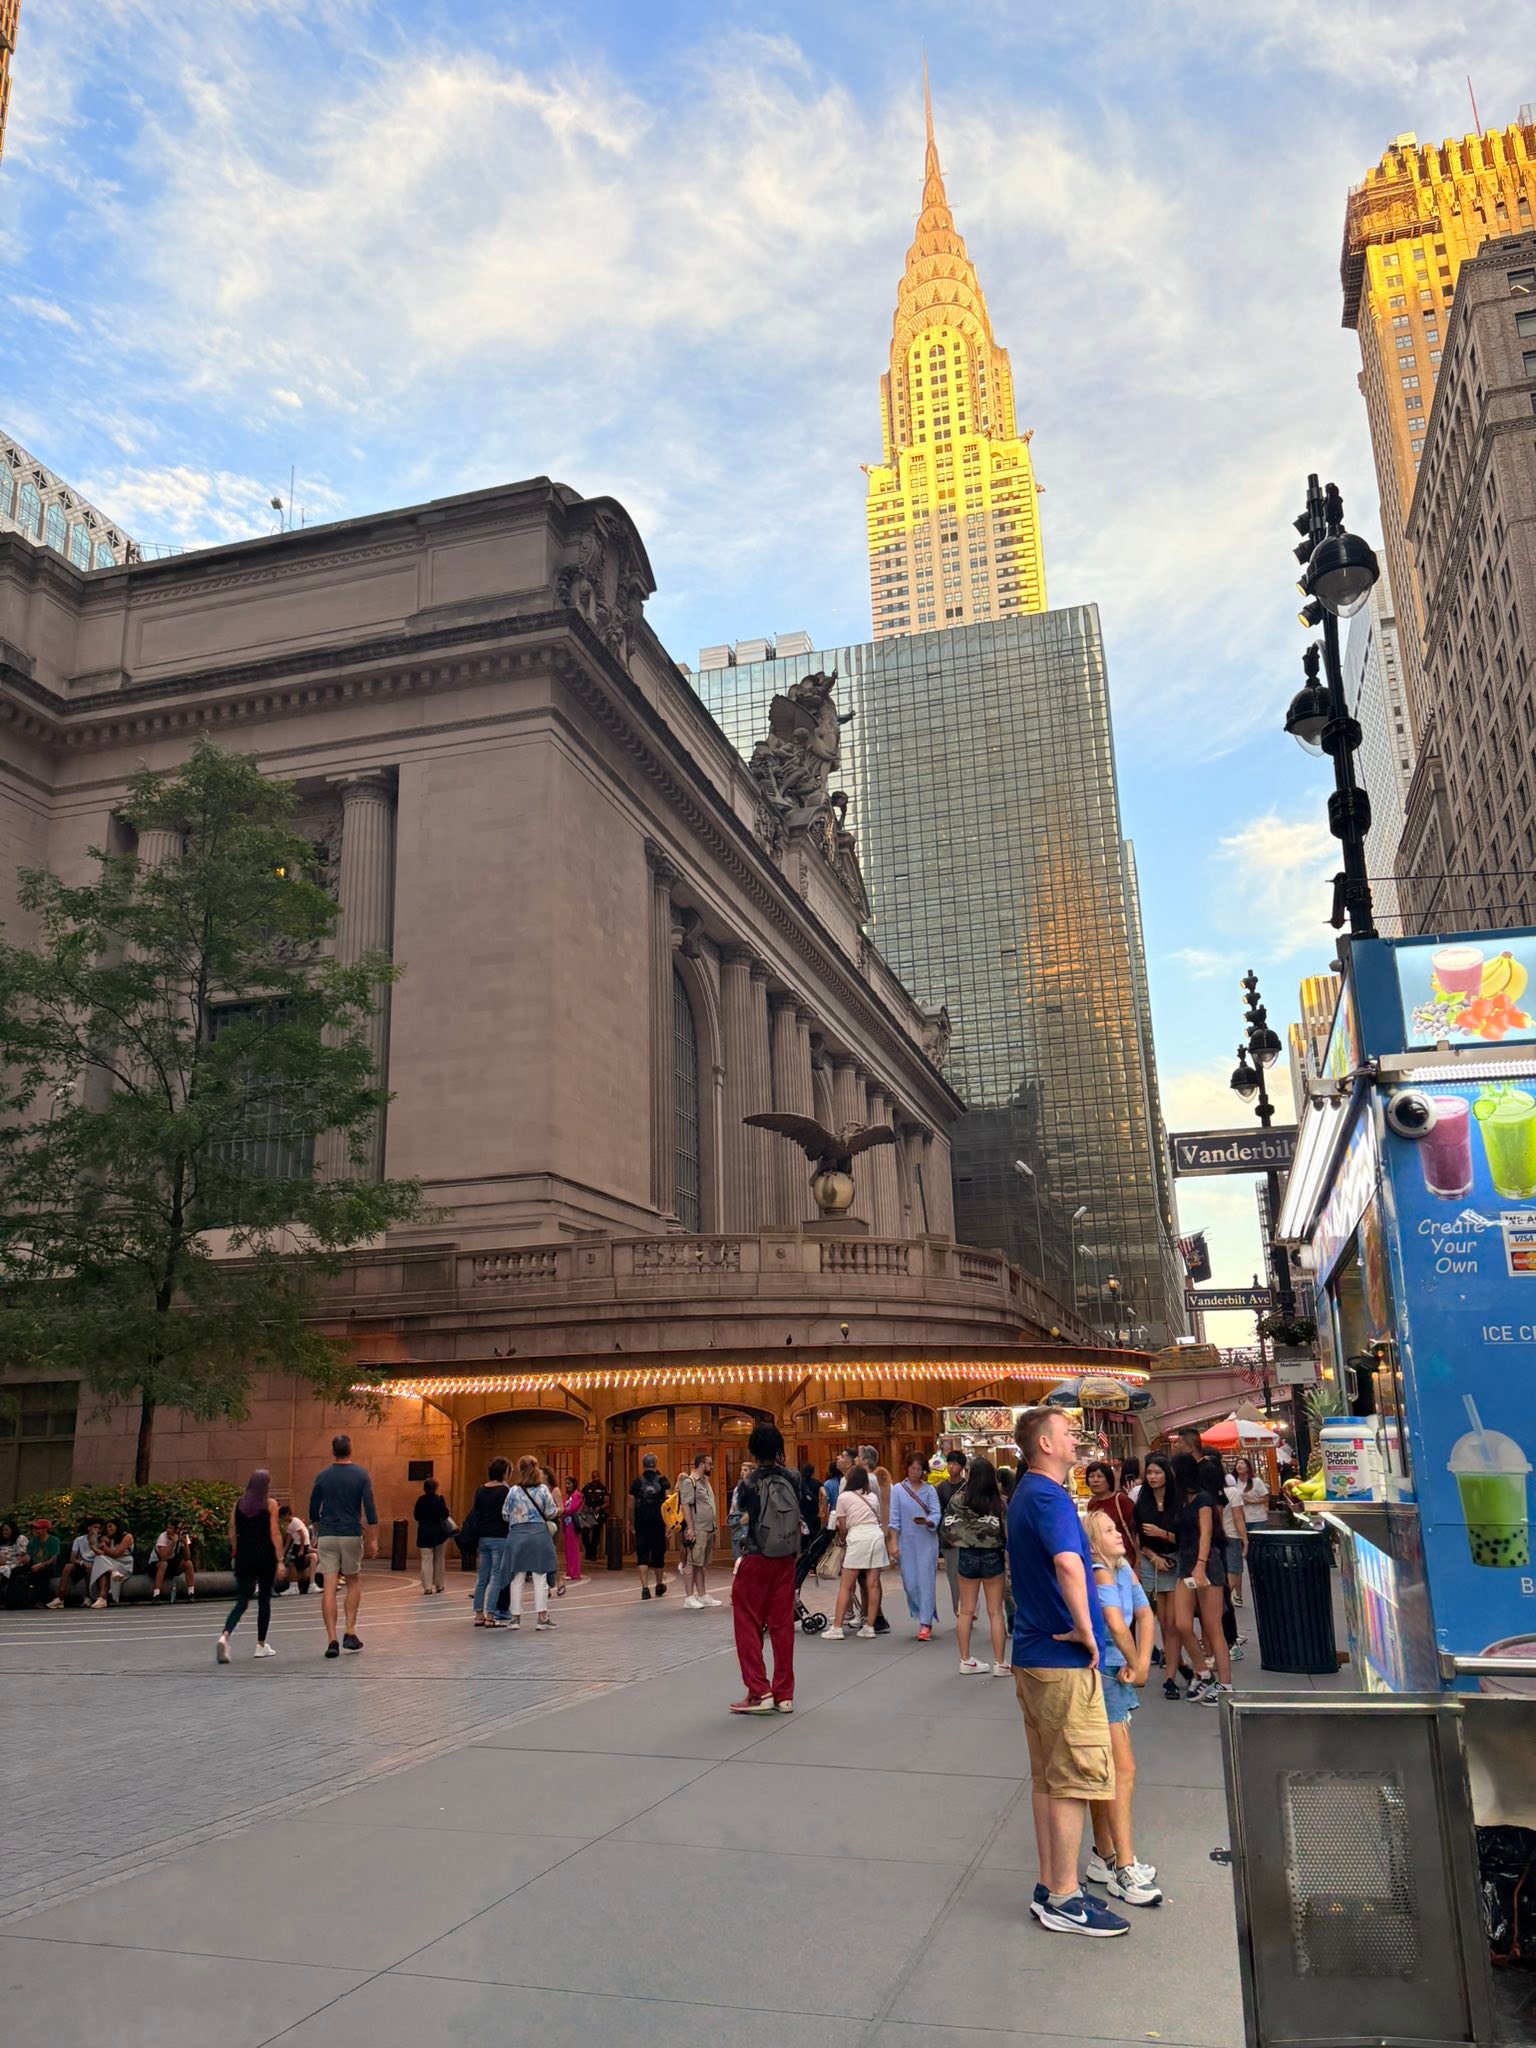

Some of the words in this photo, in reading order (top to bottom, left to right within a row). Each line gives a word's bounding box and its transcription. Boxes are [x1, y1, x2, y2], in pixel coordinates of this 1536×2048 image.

[1418, 1219, 1485, 1235] Create
[1431, 1238, 1477, 1254] Your
[1515, 1234, 1534, 1242] VISA
[1436, 1257, 1478, 1274] Own
[1189, 1295, 1246, 1306] Vanderbilt
[1249, 1294, 1270, 1304] Ave
[1482, 1325, 1514, 1341] ICE
[1520, 1325, 1536, 1341] C
[1325, 1450, 1358, 1458] Organic
